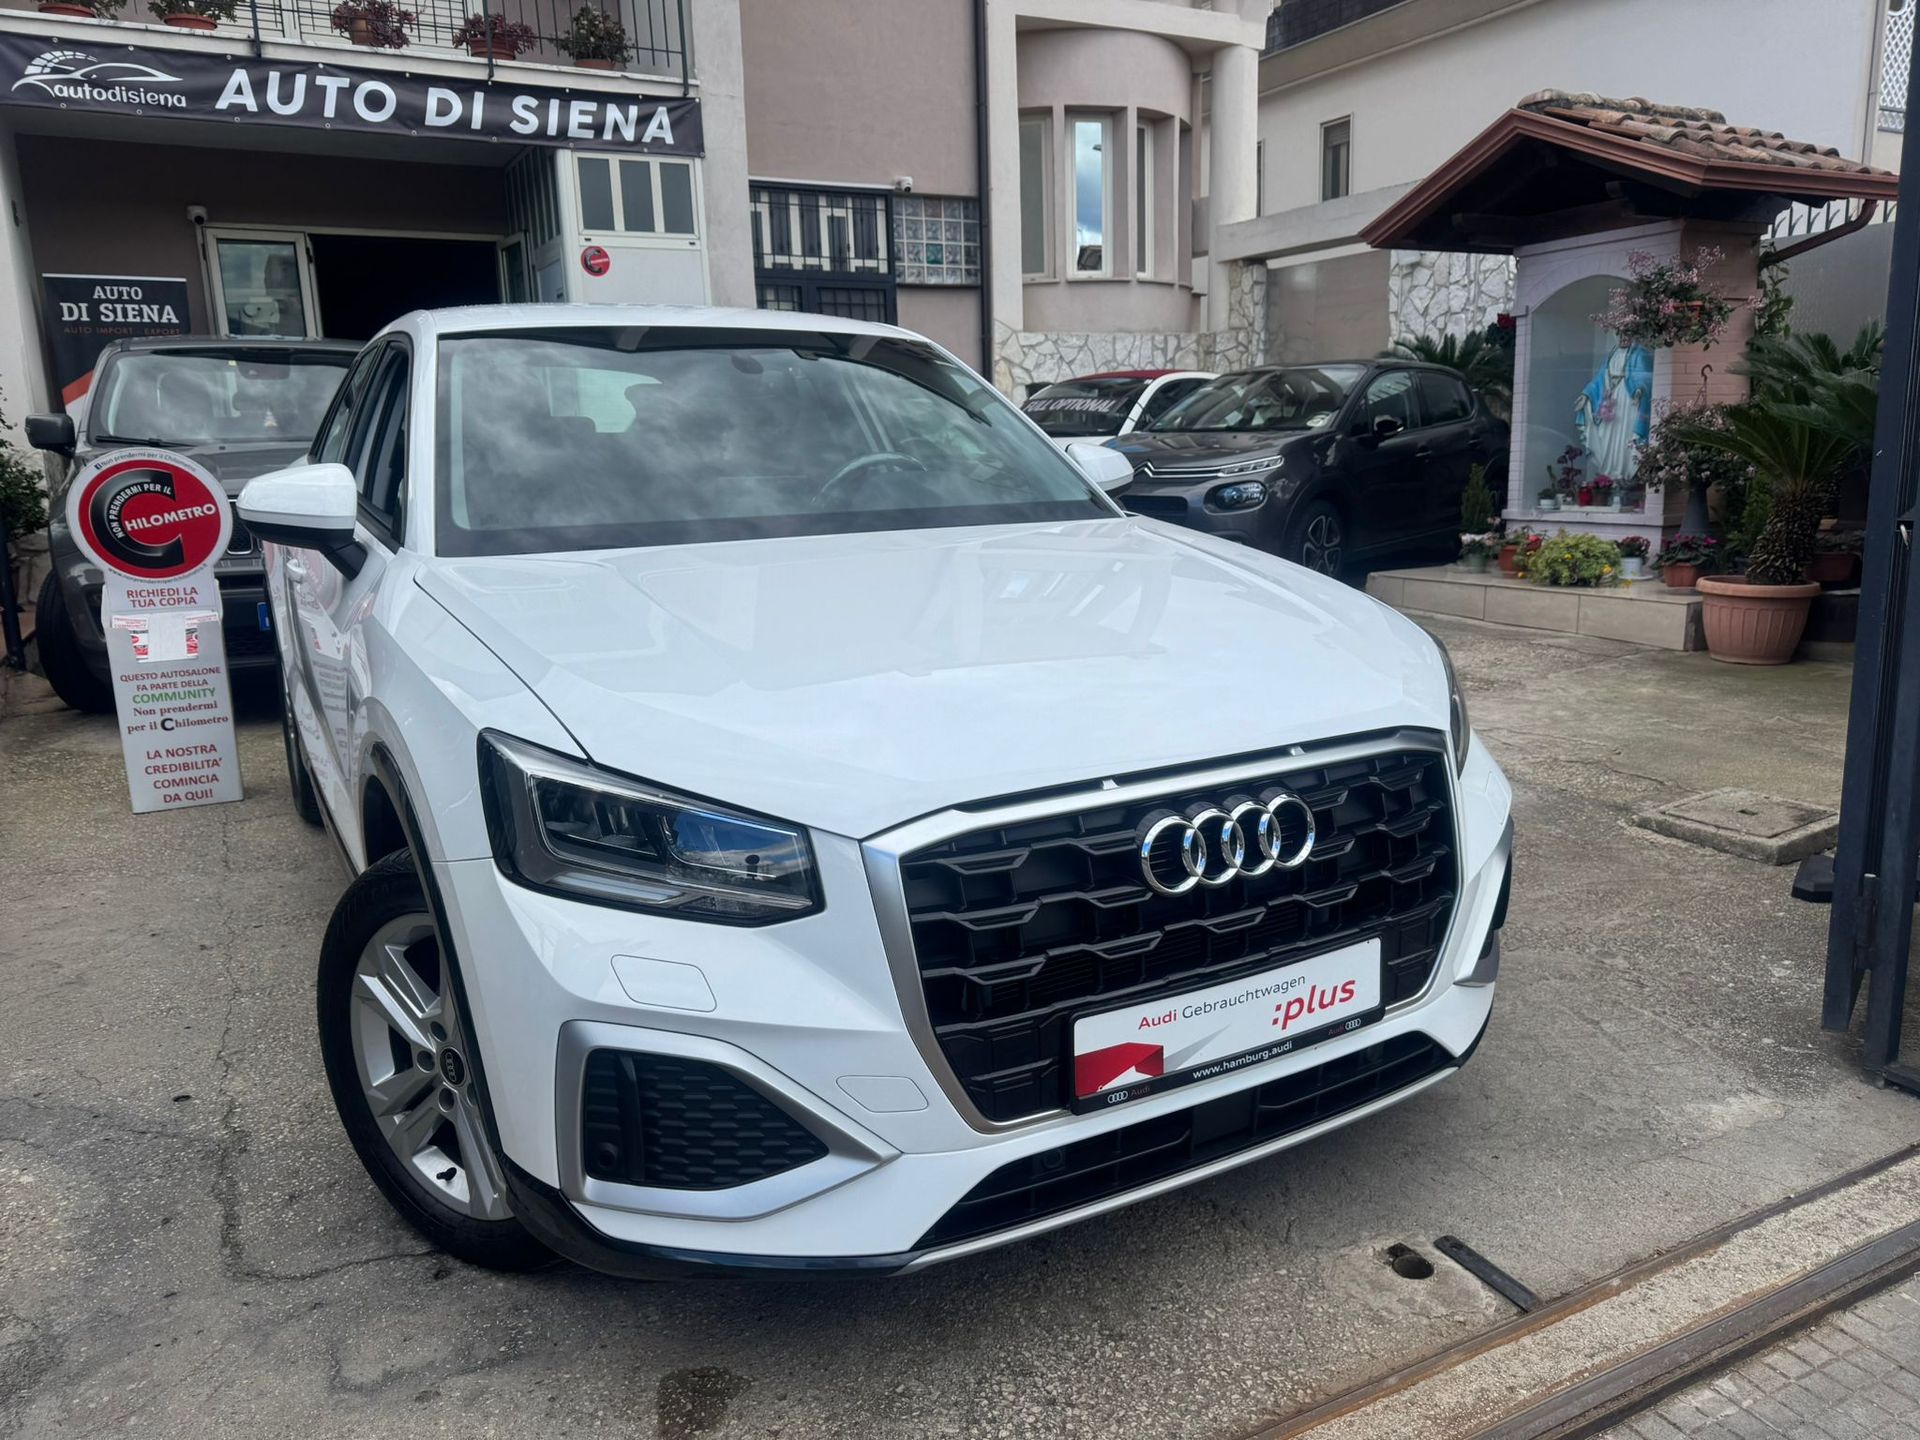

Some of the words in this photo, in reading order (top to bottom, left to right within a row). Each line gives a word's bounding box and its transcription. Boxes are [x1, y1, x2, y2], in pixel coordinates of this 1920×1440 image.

[53, 83, 187, 108] autodisiena
[214, 68, 397, 123] AUTO
[424, 87, 484, 130] DI
[509, 95, 675, 146] SIENA
[92, 285, 143, 300] AUTO
[59, 302, 90, 321] DI
[98, 302, 180, 324] SIENA
[63, 326, 92, 335] AUTO
[96, 326, 133, 336] IMPORT
[144, 327, 180, 337] EXPORT
[1048, 398, 1116, 413] OPTIONAL
[143, 483, 161, 491] PER
[163, 485, 172, 495] IL
[108, 484, 142, 520] PRENDERMI
[109, 521, 125, 539] NON
[126, 588, 180, 599] RICHIEDI
[182, 586, 199, 596] LA
[129, 598, 157, 608] TUA
[159, 596, 198, 607] COPIA
[120, 672, 158, 683] QUESTO
[160, 666, 221, 679] AUTOSALONE
[136, 684, 148, 692] FA
[150, 681, 179, 691] PARTE
[180, 678, 208, 688] DELLA
[132, 687, 216, 704] COMMUNITY
[133, 707, 156, 717] Non
[159, 700, 218, 717] prendermi
[127, 724, 146, 735] per
[149, 721, 158, 731] il
[160, 715, 229, 732] Chilometro
[146, 750, 162, 760] LA
[165, 743, 218, 758] NOSTRA
[153, 773, 220, 790] COMINCIA
[163, 792, 182, 804] DA
[184, 788, 213, 802] QUI!
[1137, 1009, 1178, 1031] Audi
[1181, 974, 1306, 1020] Gebrauchtwagen
[1192, 1040, 1293, 1079] www.hamburg.audi
[1130, 1087, 1151, 1097] Audi
